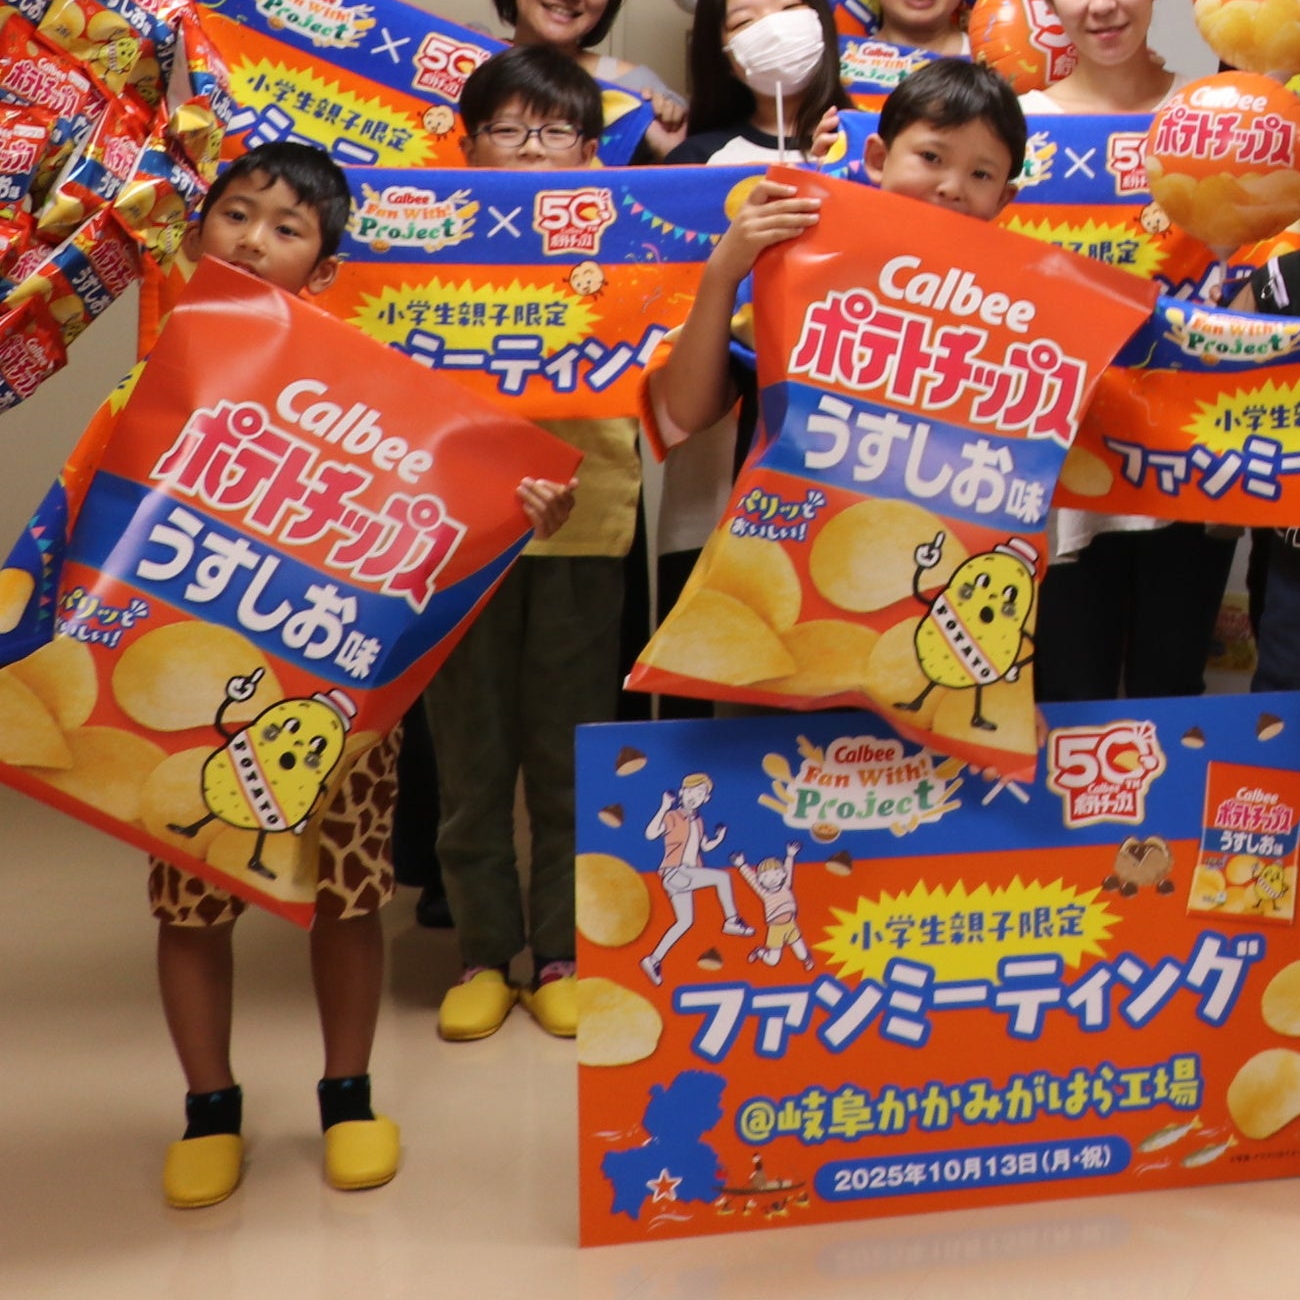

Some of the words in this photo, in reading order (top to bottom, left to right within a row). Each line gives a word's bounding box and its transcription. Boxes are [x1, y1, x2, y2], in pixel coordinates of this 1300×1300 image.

[248, 74, 414, 151] 小学生親子限定
[1189, 86, 1268, 112] Calbee
[1154, 106, 1297, 168] ポテトチップス
[365, 203, 398, 219] Fan
[402, 203, 453, 220] With!
[387, 191, 430, 205] Calbee
[539, 196, 602, 224] 50
[359, 217, 456, 241] Project
[878, 254, 1036, 334] Calbee
[378, 302, 570, 327] 小学生親子限定
[1187, 333, 1284, 356] Project
[788, 287, 1088, 448] ポテトチップス
[276, 378, 434, 483] Calbee
[804, 395, 1048, 526] うすしお味
[150, 398, 469, 615] ポテトチップス
[737, 487, 819, 522] パリッと
[730, 517, 807, 543] おいしい!
[135, 507, 385, 681] うすしお味
[936, 602, 993, 679] POTATO
[834, 741, 896, 766] Calbee
[1053, 733, 1143, 786] 50
[232, 736, 281, 828] POTATO
[801, 765, 854, 790] Fan
[857, 755, 930, 788] With!
[1087, 782, 1122, 794] Calbee
[792, 780, 935, 820] Project
[1073, 792, 1135, 815] ポテトチップス
[1236, 785, 1280, 806] Calbee
[1215, 801, 1294, 836] ポテトチップス
[1218, 830, 1286, 858] うすしお味
[849, 903, 1087, 952] 小学生親子限定
[677, 936, 1263, 1059] ファンミーティング
[740, 1057, 1202, 1142] @岐阜かかみがはら工場
